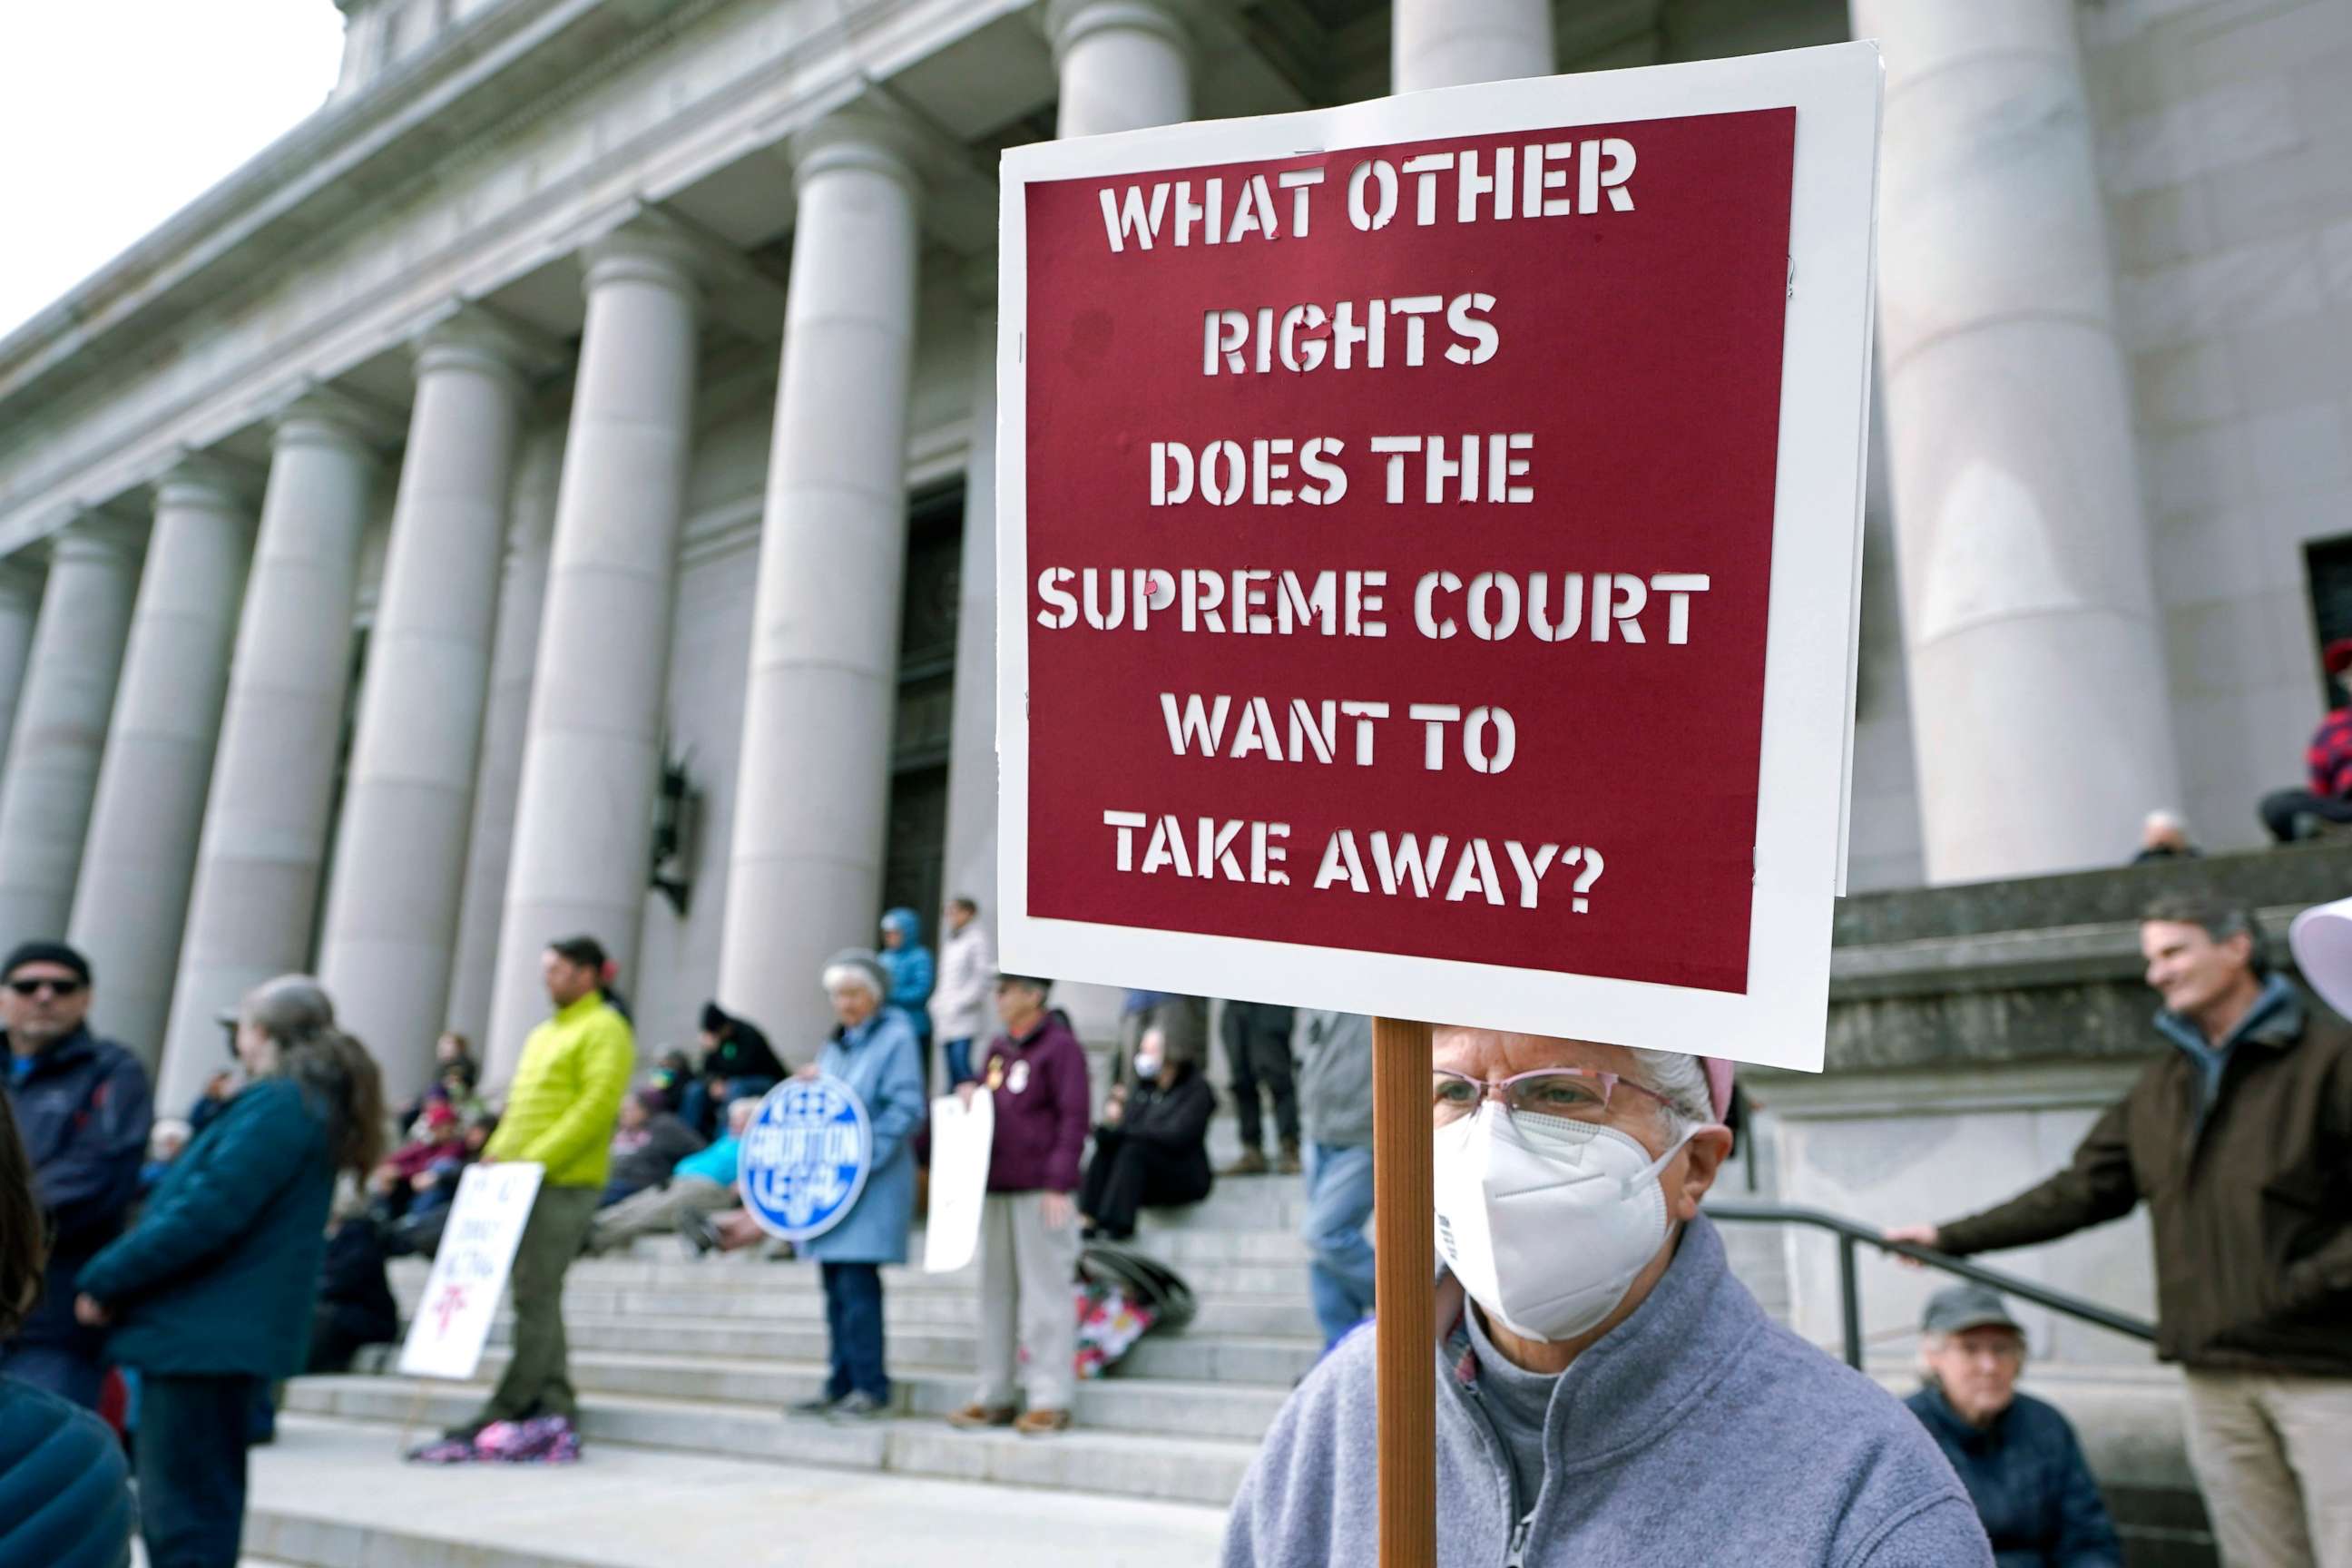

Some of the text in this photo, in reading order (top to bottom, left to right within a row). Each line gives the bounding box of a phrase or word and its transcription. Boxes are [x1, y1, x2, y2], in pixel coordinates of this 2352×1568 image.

[1098, 138, 1637, 252] WHAT OTHER
[1203, 293, 1499, 376] RIGHTS
[1150, 434, 1534, 506] DOES THE
[1036, 567, 1710, 644] SUPREME COURT
[1160, 692, 1516, 774] WANT TO
[1102, 809, 1604, 914] TAKE AWAY?
[771, 1086, 848, 1122] KEEP
[748, 1124, 859, 1167] ABORTION
